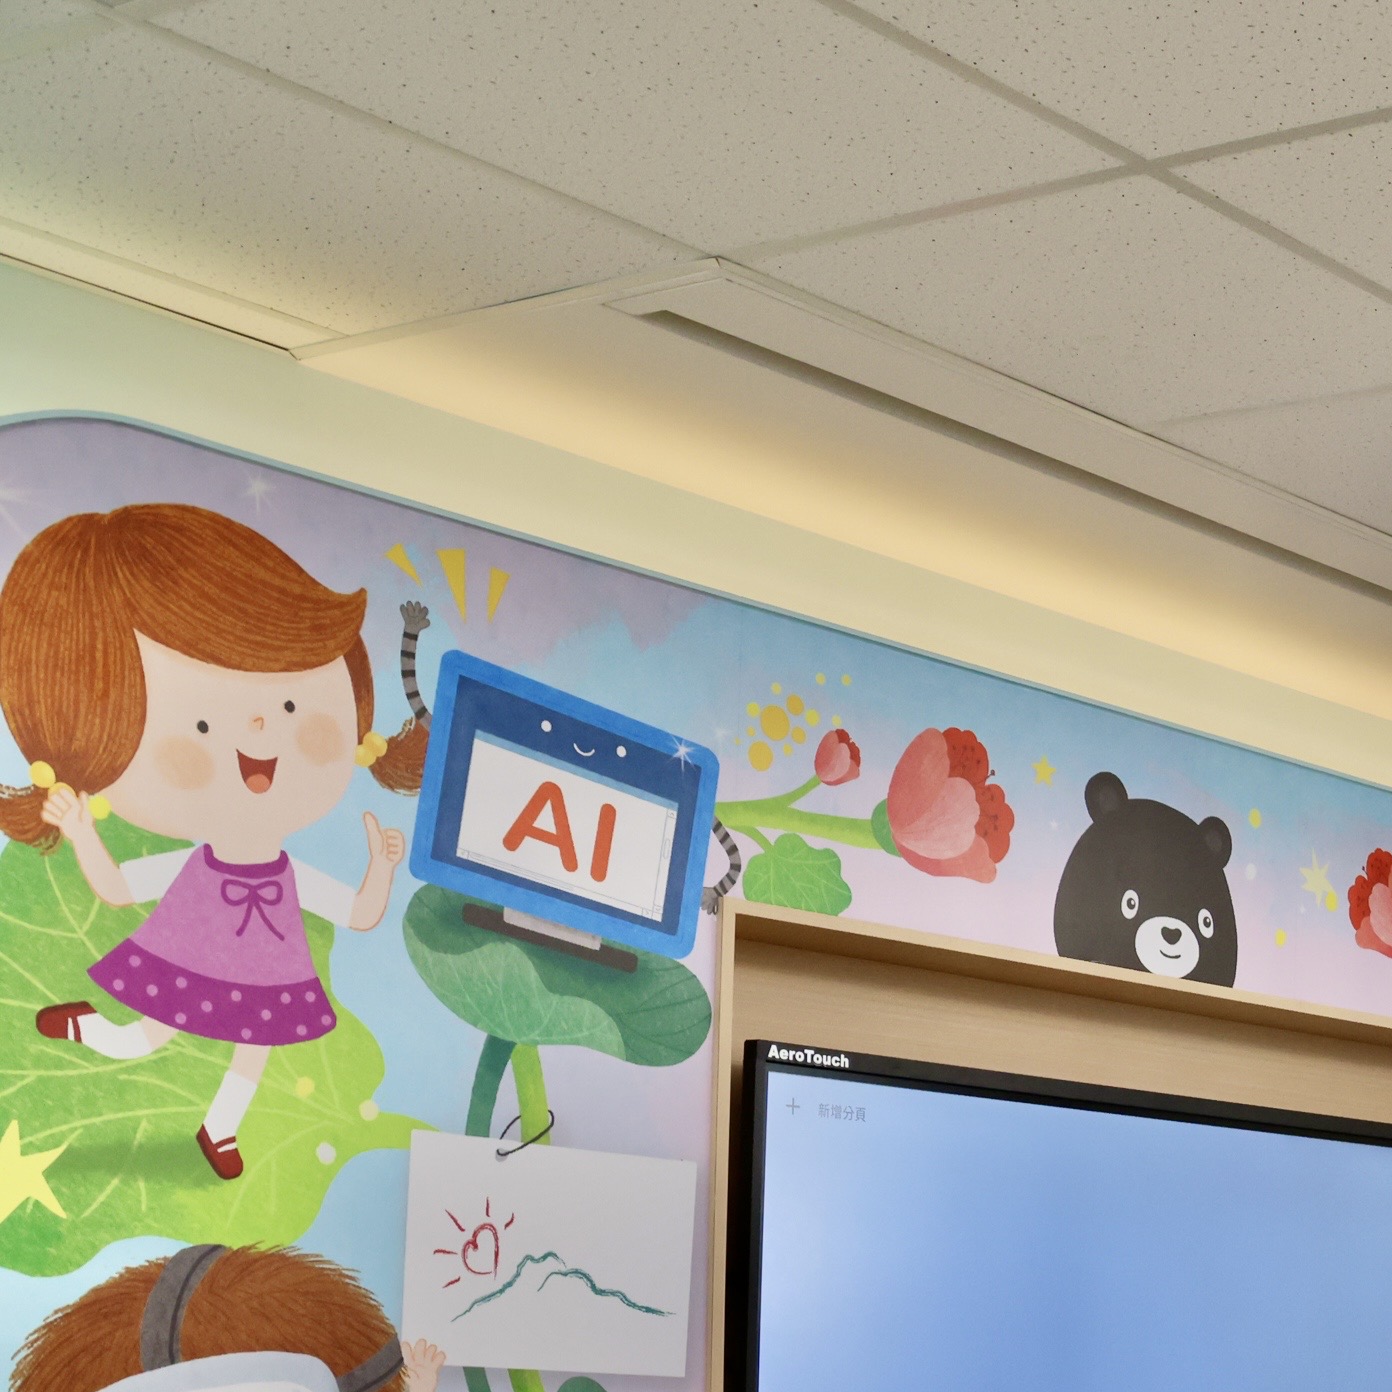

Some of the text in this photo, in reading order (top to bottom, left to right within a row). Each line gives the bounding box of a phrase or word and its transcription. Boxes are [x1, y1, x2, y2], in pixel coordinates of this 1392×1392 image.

[502, 781, 616, 882] AI
[768, 1044, 850, 1068] AeroTouch
[818, 1102, 866, 1122] 新增分頁
